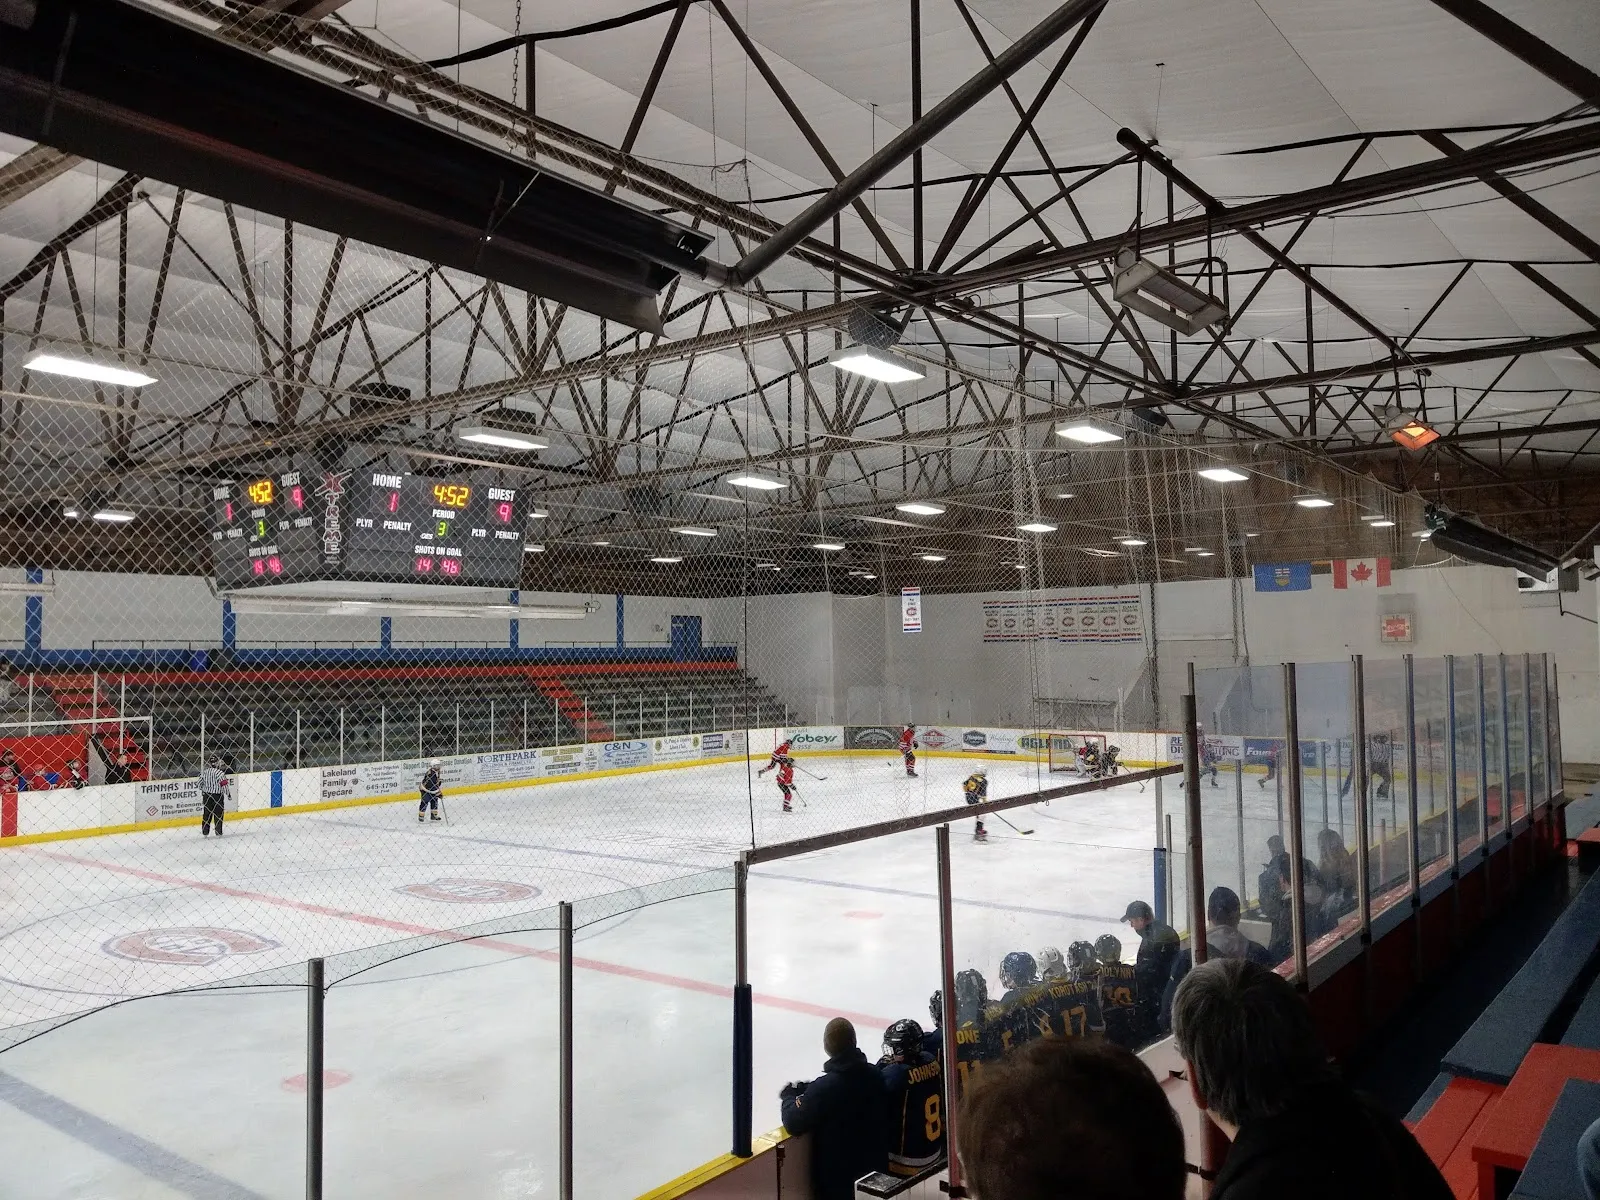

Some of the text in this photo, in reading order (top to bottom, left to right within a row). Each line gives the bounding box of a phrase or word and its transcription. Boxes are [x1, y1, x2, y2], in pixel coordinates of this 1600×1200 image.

[281, 471, 300, 487] GUEST
[372, 473, 402, 488] HOME
[213, 486, 230, 500] HOME
[248, 480, 273, 503] 4:52
[433, 484, 469, 507] 4:52
[488, 488, 515, 501] GUEST
[292, 488, 303, 510] 9
[389, 491, 400, 514] 1
[225, 503, 233, 521] 1
[251, 508, 266, 519] PERIOD
[432, 509, 456, 519] PERIOD
[499, 503, 511, 522] 9
[258, 521, 265, 537] 3
[279, 520, 290, 530] PLYR
[294, 516, 313, 528] PENALTY
[356, 518, 412, 531] PLYR PENALTY
[437, 521, 446, 537] 3
[471, 528, 519, 540] PLYR PENALTY
[414, 545, 462, 557] SHOTS ON GOAL
[269, 556, 282, 573] 46
[416, 558, 459, 574] 14 46
[604, 742, 631, 751] C&N
[477, 750, 537, 764] NORTHPARK
[322, 768, 357, 778] Lakeland
[141, 782, 179, 794] TANNAS
[322, 779, 348, 788] Family
[160, 790, 198, 800] BROKERS
[322, 788, 353, 799] Eyecare
[161, 808, 193, 816] Insurance
[1061, 1005, 1087, 1037] 17
[925, 1094, 941, 1142] 8
